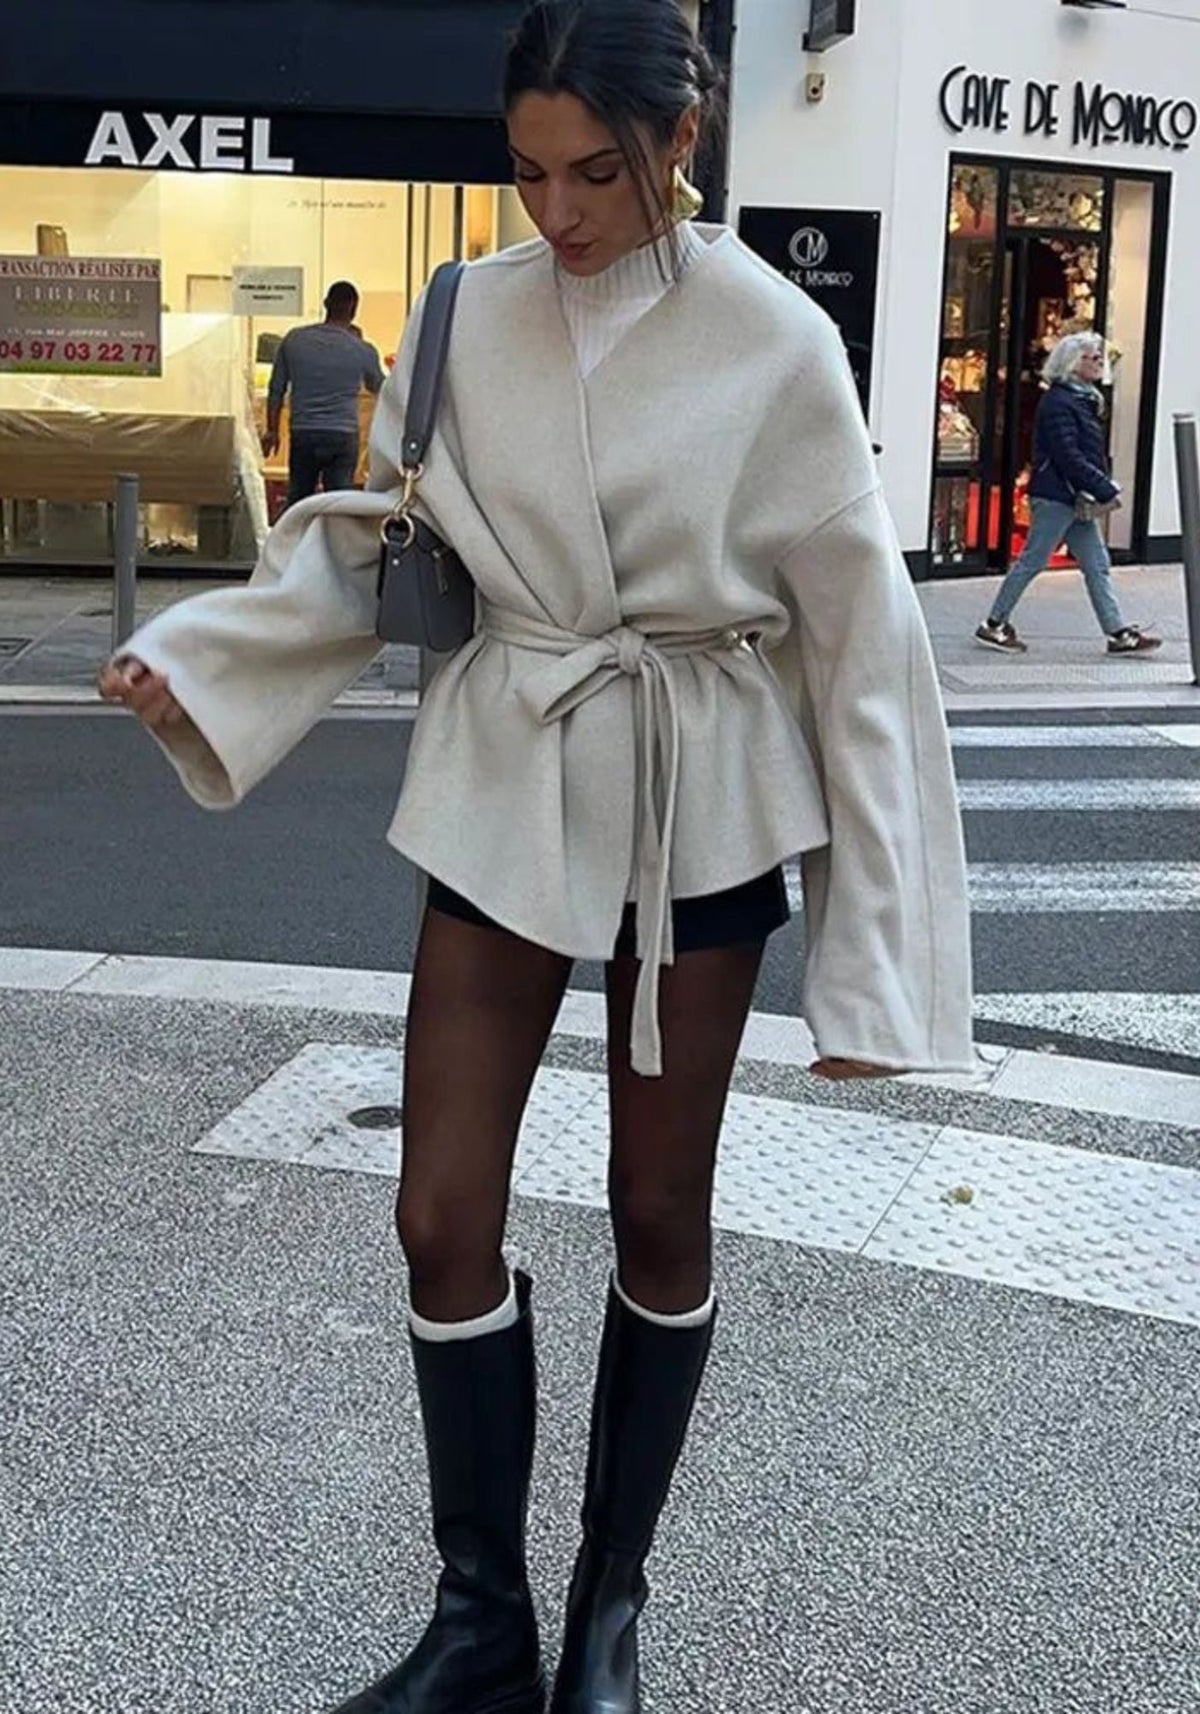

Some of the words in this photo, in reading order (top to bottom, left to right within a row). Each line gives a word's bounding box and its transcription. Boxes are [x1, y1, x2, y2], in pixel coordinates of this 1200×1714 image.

[938, 66, 1010, 133] CAVE
[1024, 81, 1059, 135] DE
[1072, 81, 1197, 150] MONACO
[84, 111, 294, 172] AXEL
[0, 340, 23, 359] 04
[30, 340, 55, 359] 97
[64, 341, 91, 361] 03
[97, 342, 124, 361] 22
[131, 343, 156, 362] 77
